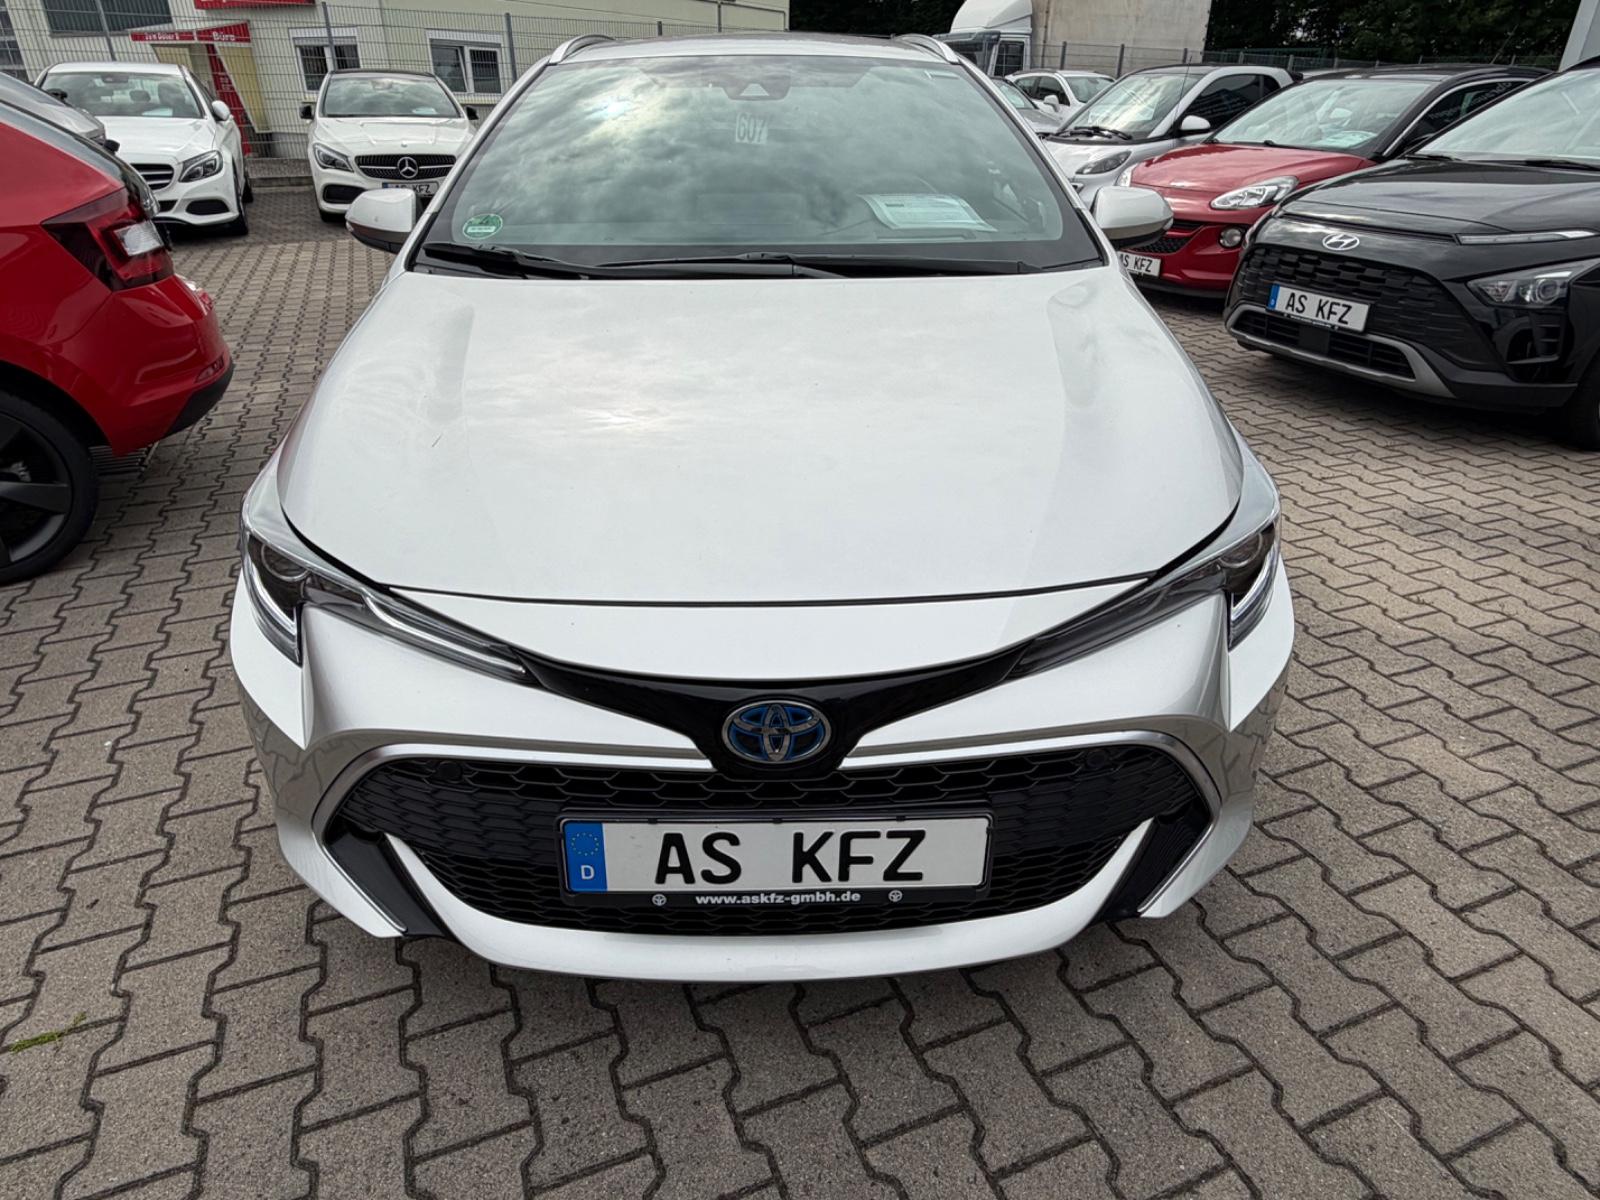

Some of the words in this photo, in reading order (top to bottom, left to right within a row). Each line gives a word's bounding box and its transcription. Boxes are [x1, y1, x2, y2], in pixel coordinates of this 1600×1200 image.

[1134, 256, 1153, 273] KFZ
[1285, 292, 1308, 314] AS
[1315, 298, 1353, 325] KFZ
[654, 831, 742, 885] AS
[791, 830, 927, 884] KFZ
[581, 865, 594, 879] D
[695, 890, 861, 905] www.askfz-gmbh.de
